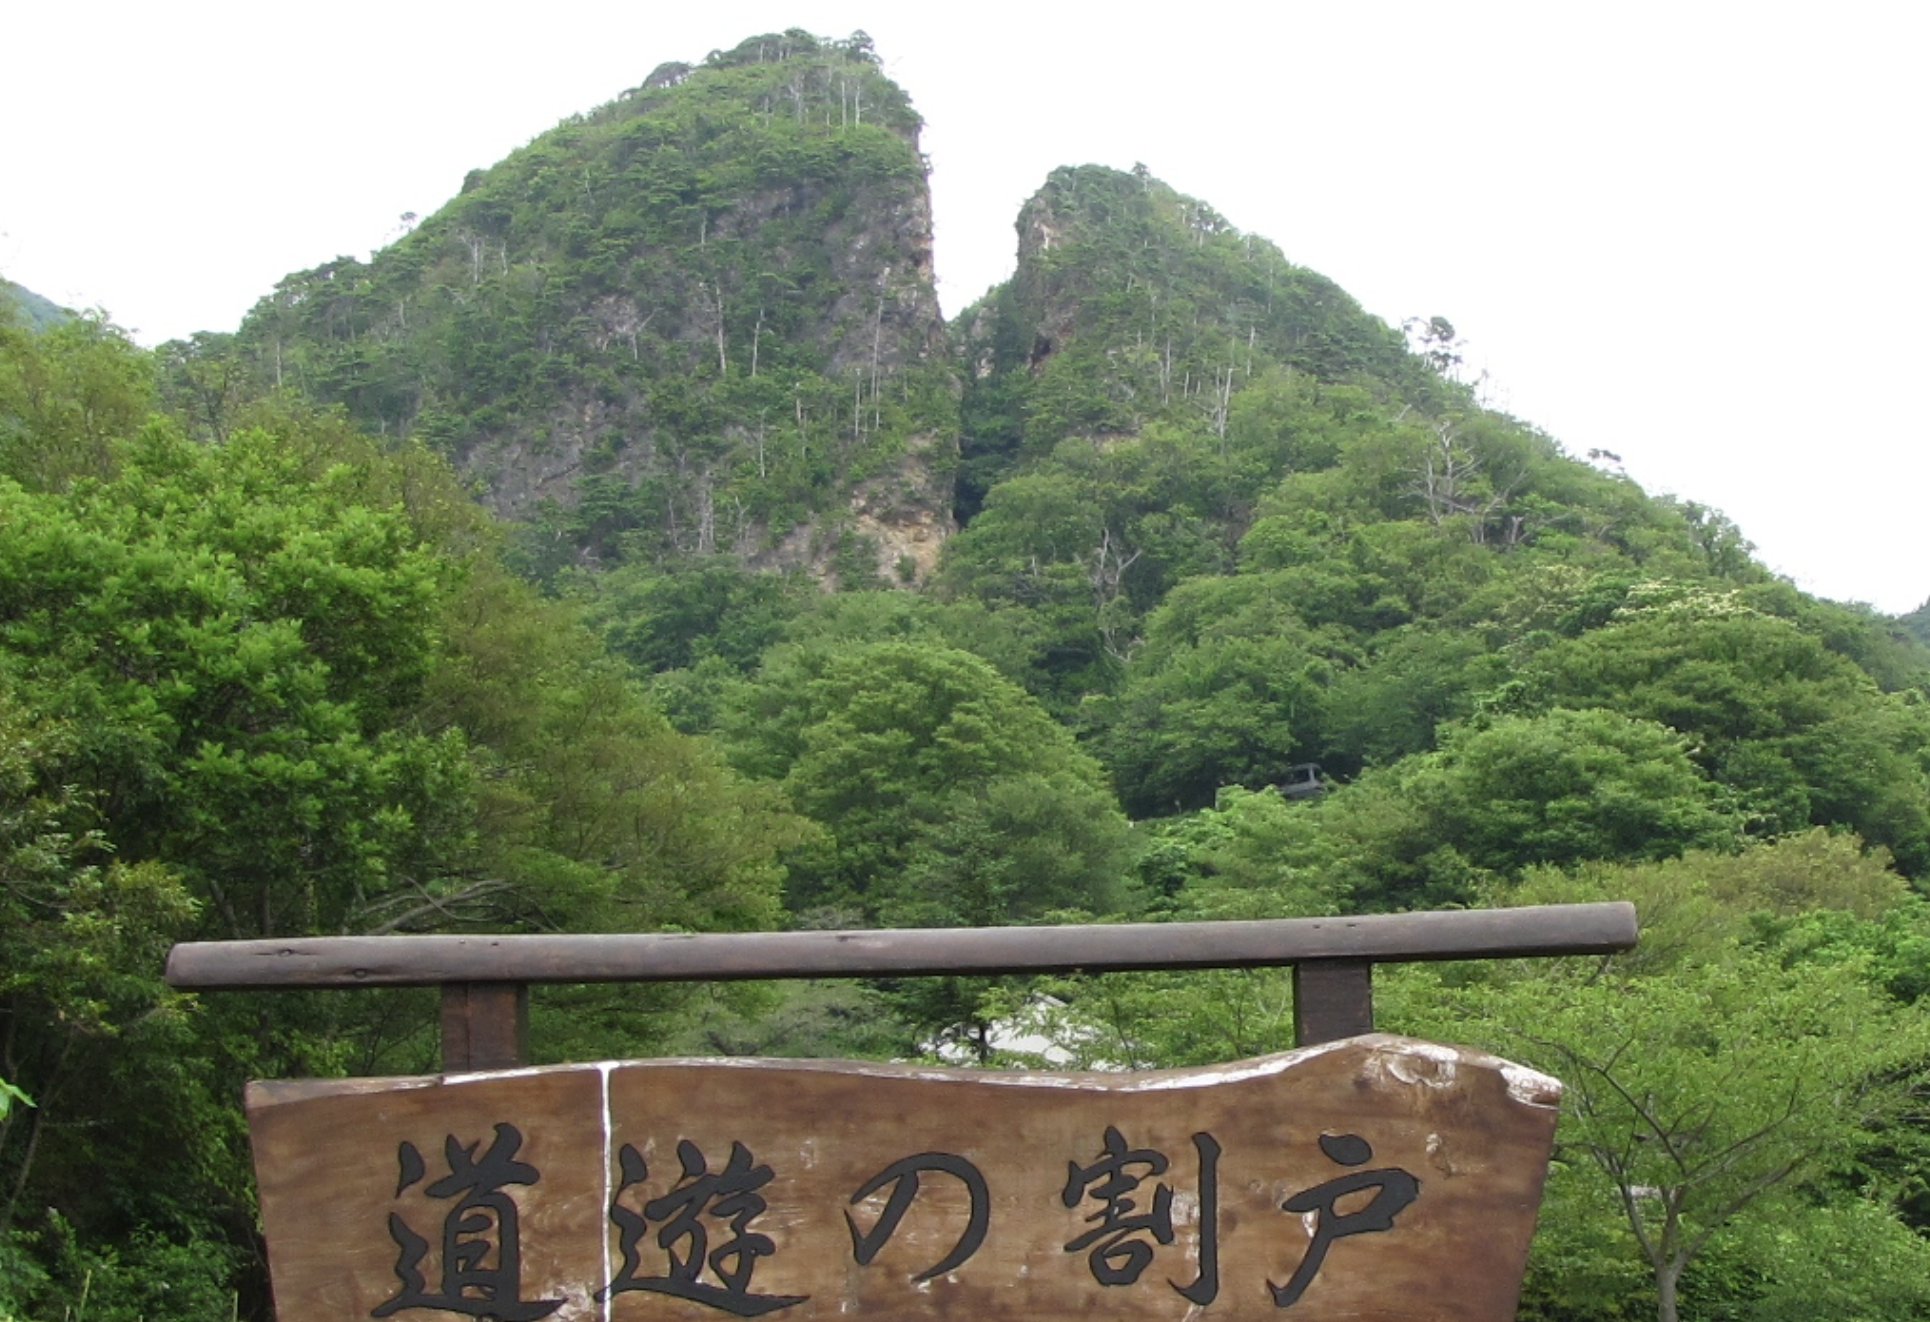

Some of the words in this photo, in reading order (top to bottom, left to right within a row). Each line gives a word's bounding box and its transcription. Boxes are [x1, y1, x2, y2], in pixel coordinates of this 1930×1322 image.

[370, 1121, 1421, 1322] 道遊の割戸
